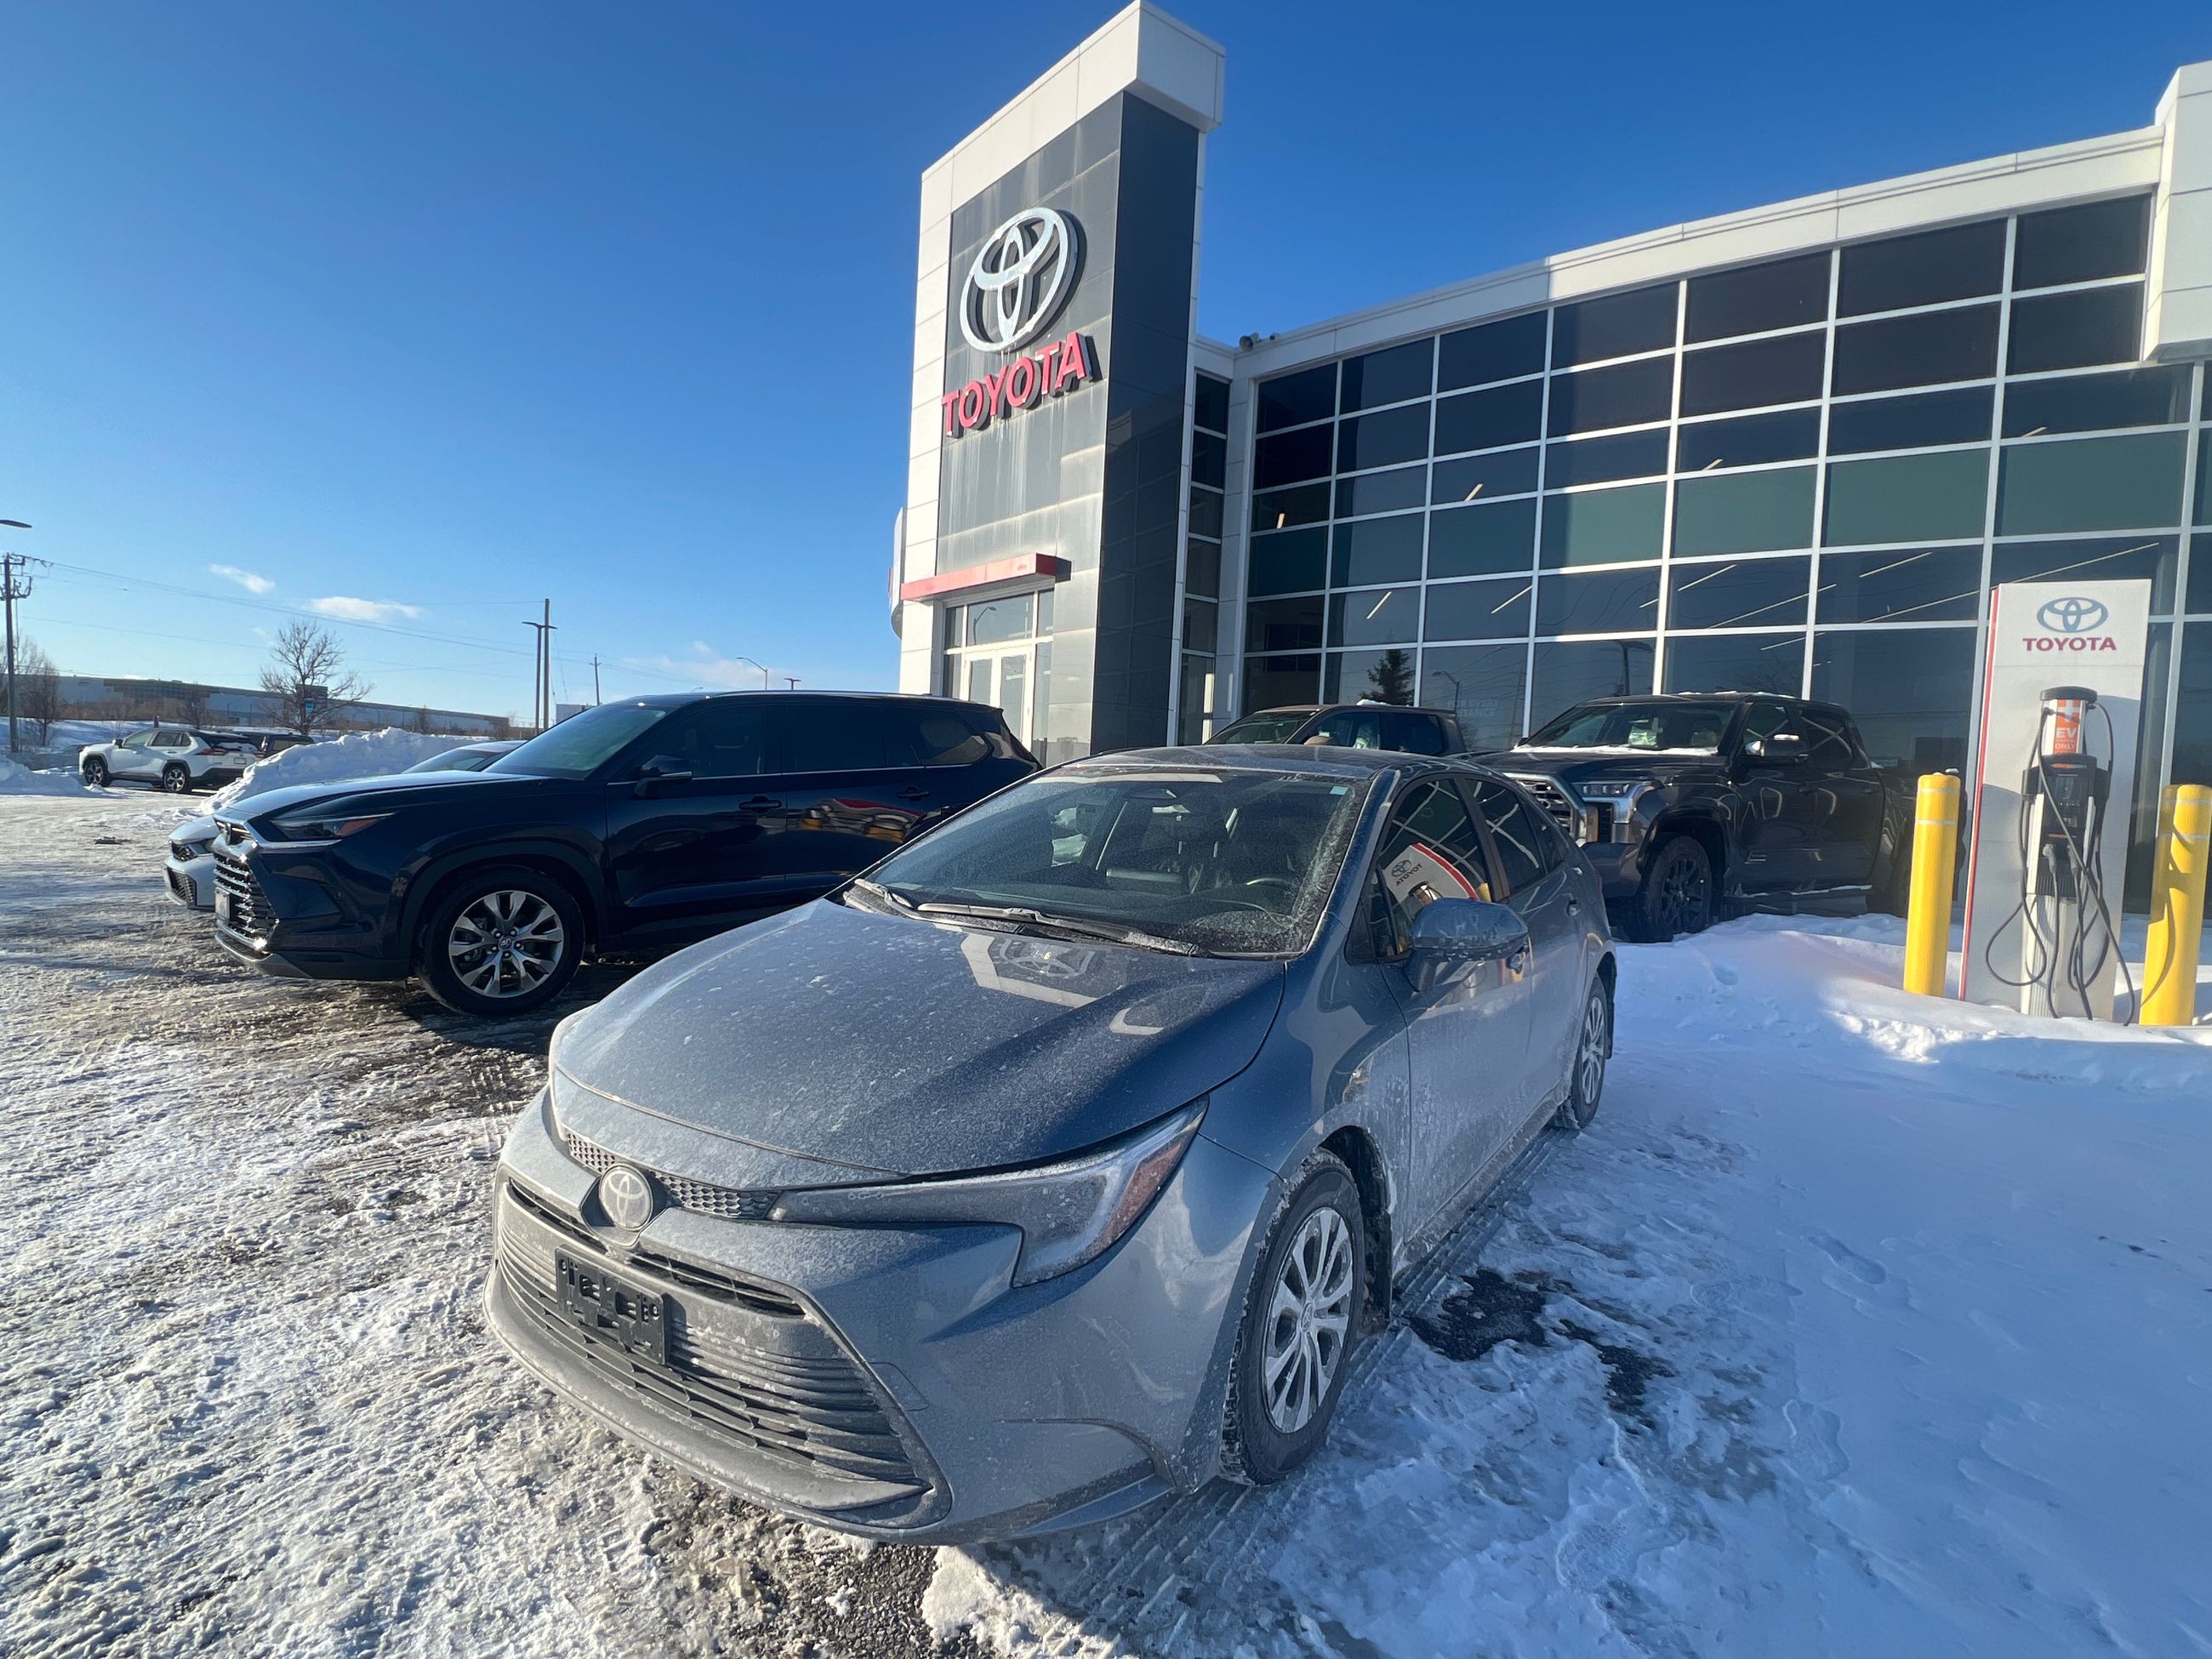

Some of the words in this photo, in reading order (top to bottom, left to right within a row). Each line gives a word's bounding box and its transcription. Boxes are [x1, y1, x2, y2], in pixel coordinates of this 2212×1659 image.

[942, 332, 1091, 437] TOYOTA
[2022, 637, 2117, 652] TOYOTA
[2055, 727, 2077, 738] EV
